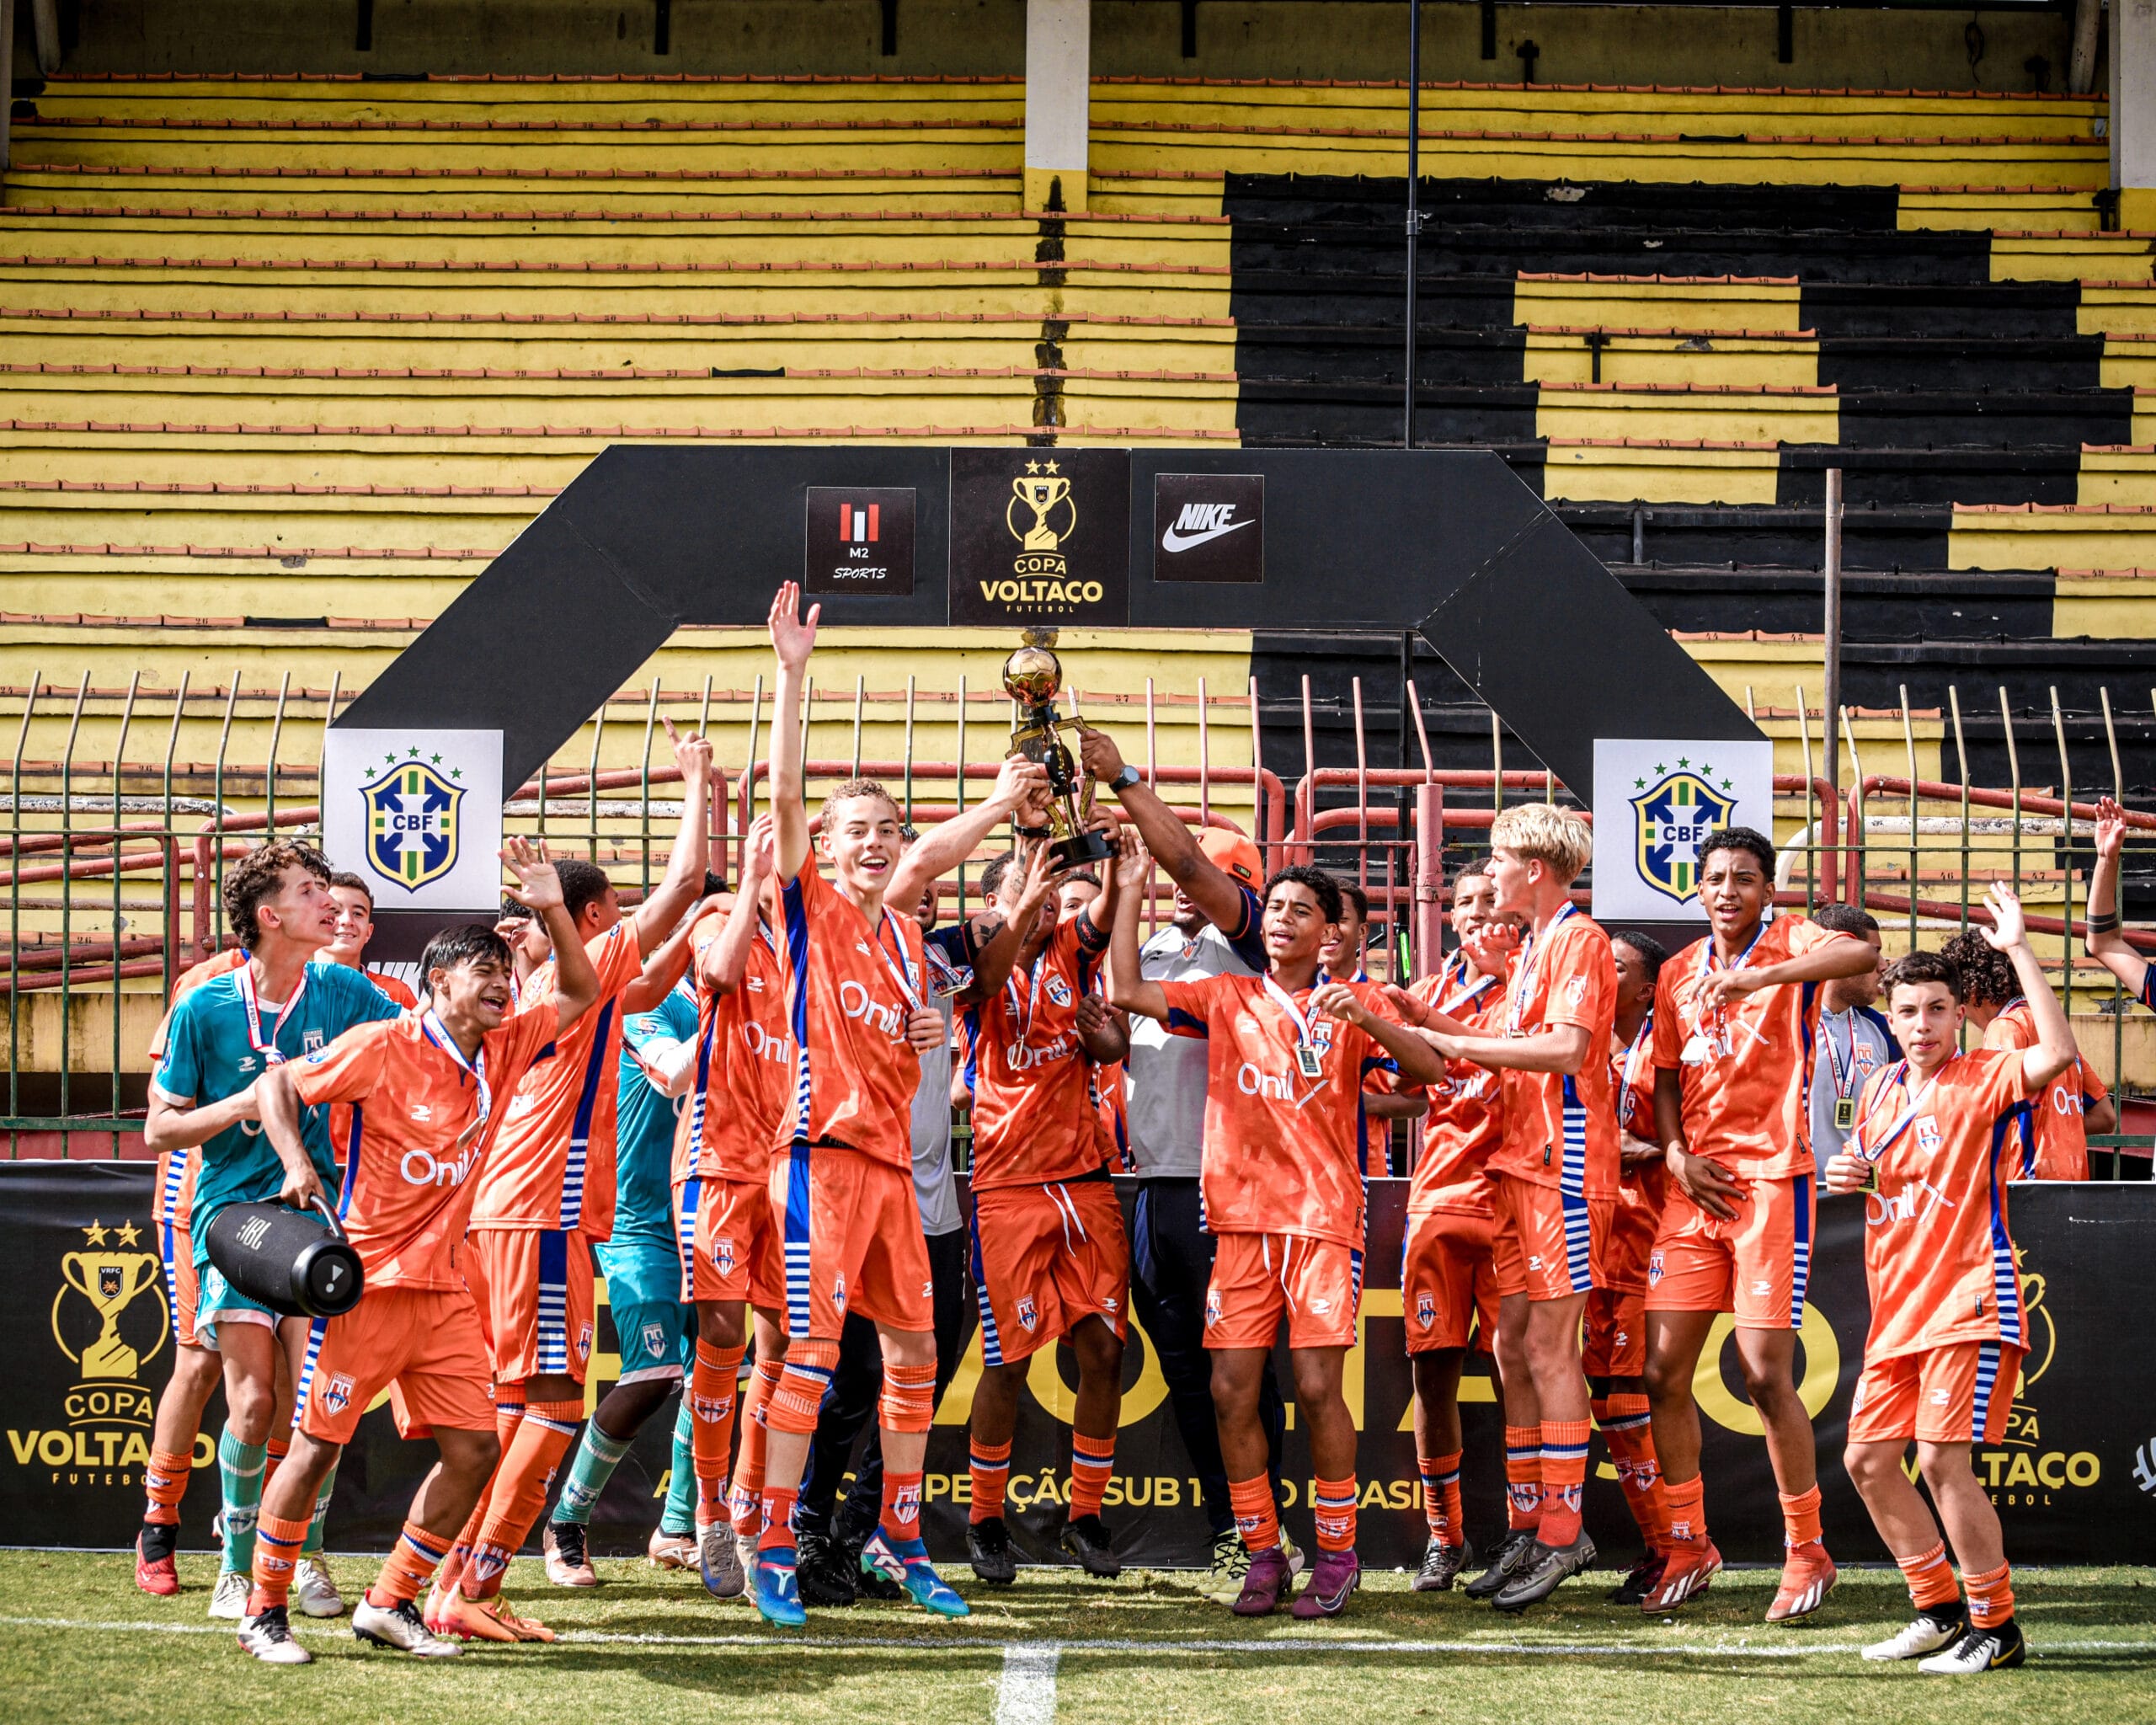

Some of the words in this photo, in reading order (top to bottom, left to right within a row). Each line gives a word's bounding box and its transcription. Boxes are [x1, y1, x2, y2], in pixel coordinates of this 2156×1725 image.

[1176, 504, 1236, 531] NIKE
[849, 548, 869, 558] M2
[833, 567, 887, 579] SPORTS
[1013, 558, 1067, 574] COPA
[979, 580, 1103, 604] VOLTAÇO
[392, 814, 433, 830] CBF
[1663, 825, 1704, 842] CBF
[236, 1215, 272, 1251] JBL
[64, 1391, 153, 1420] COPA
[2005, 1413, 2040, 1440] PA
[7, 1429, 216, 1469] VOLTAO
[52, 1472, 147, 1486] FUTEBO
[1101, 1476, 1181, 1506] SUB
[1991, 1494, 2052, 1506] EBOL
